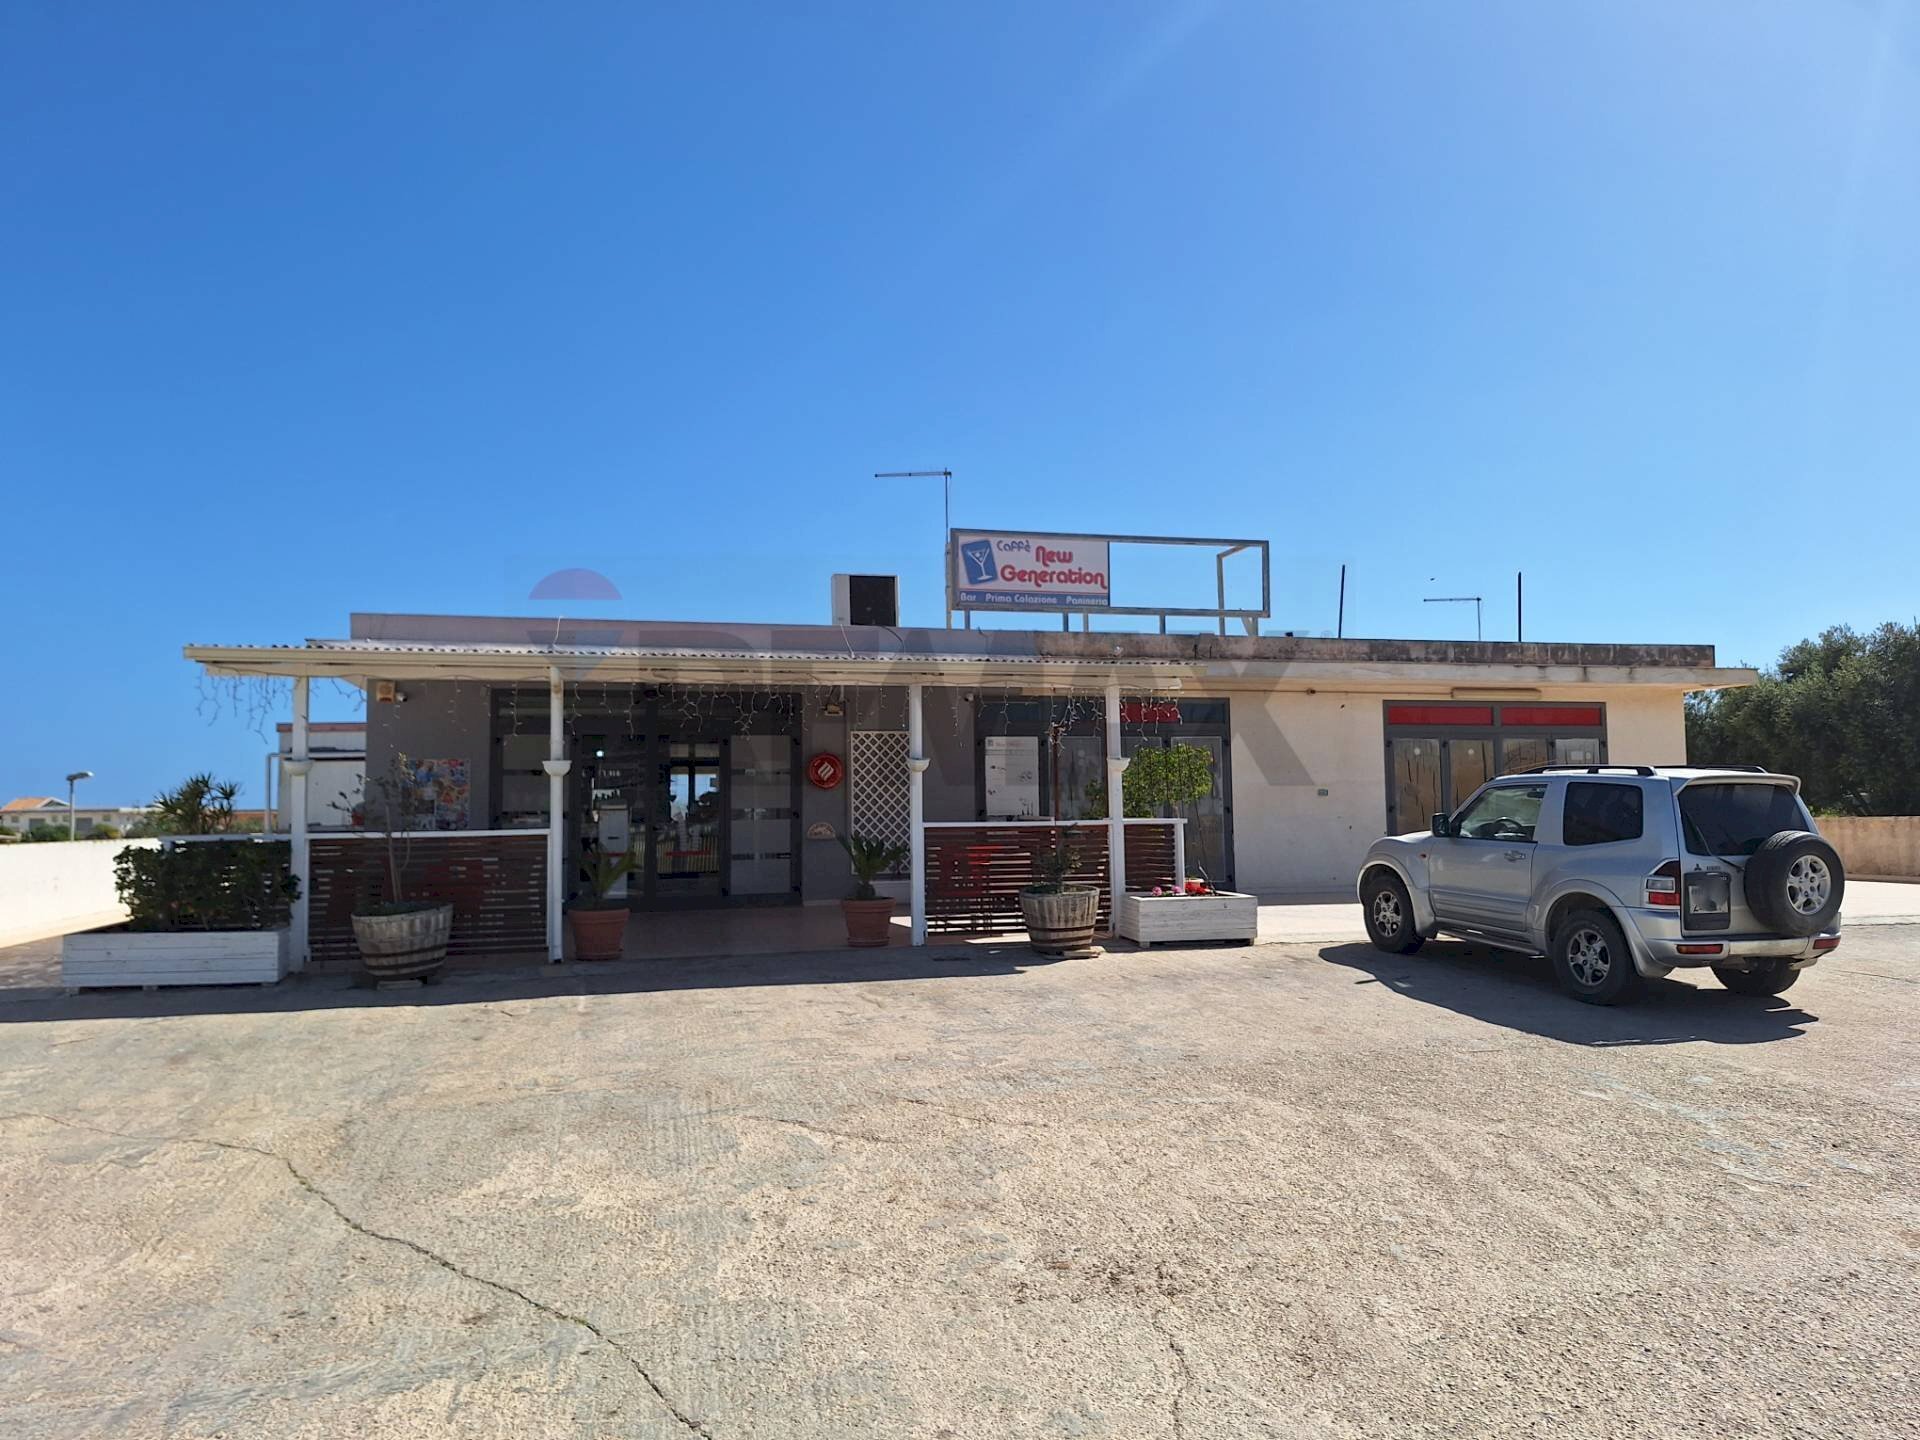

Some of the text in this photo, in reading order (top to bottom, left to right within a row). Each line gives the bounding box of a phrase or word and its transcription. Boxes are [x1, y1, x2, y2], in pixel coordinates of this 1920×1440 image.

[996, 540, 1031, 553] Caffè
[1035, 545, 1073, 567] New
[1000, 564, 1108, 590] Generation
[960, 592, 977, 601] Bar
[985, 593, 1012, 603] Prima
[1014, 594, 1057, 604] Colazione
